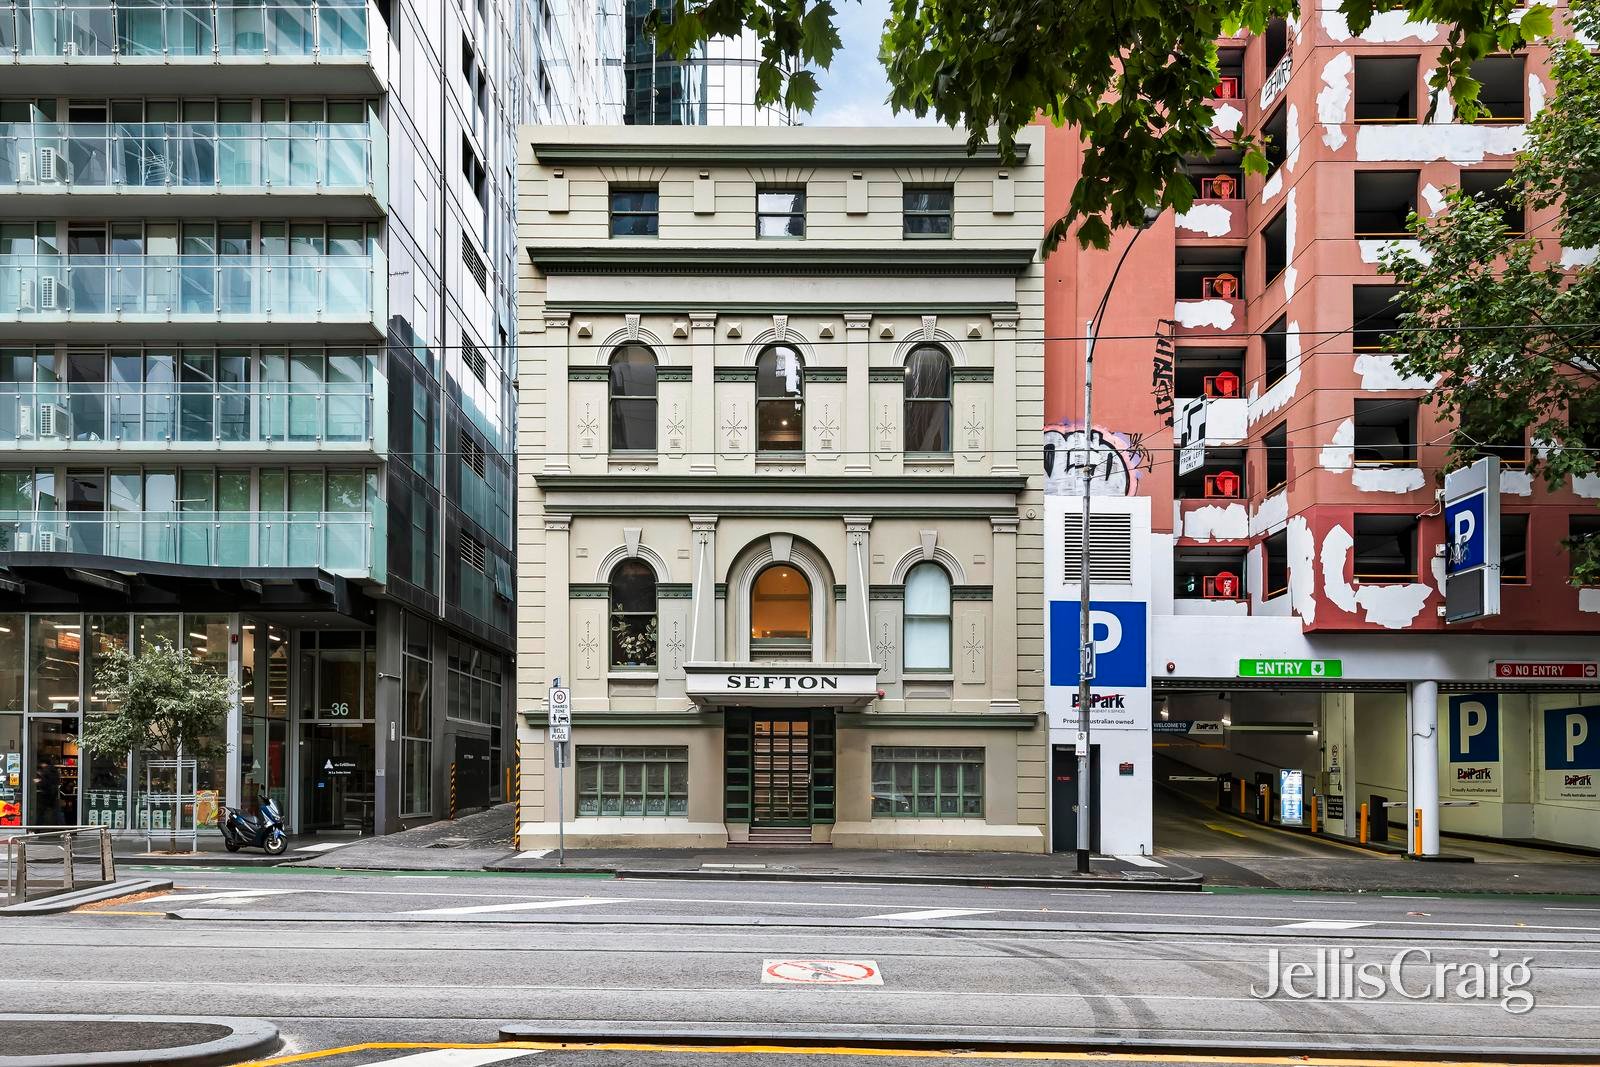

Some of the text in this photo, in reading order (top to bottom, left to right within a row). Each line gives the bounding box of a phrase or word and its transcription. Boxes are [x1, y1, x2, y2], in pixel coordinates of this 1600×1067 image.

[1181, 449, 1203, 464] FROM LEFT
[1186, 460, 1197, 469] ONLY
[1454, 509, 1475, 561] P
[1080, 610, 1122, 676] P
[1085, 647, 1091, 672] P
[1256, 662, 1303, 675] ENTRY
[1515, 665, 1565, 676] NO ENTRY
[727, 675, 838, 690] SEFTON
[331, 702, 349, 716] 36
[1460, 701, 1487, 754] P
[1566, 713, 1588, 762] P
